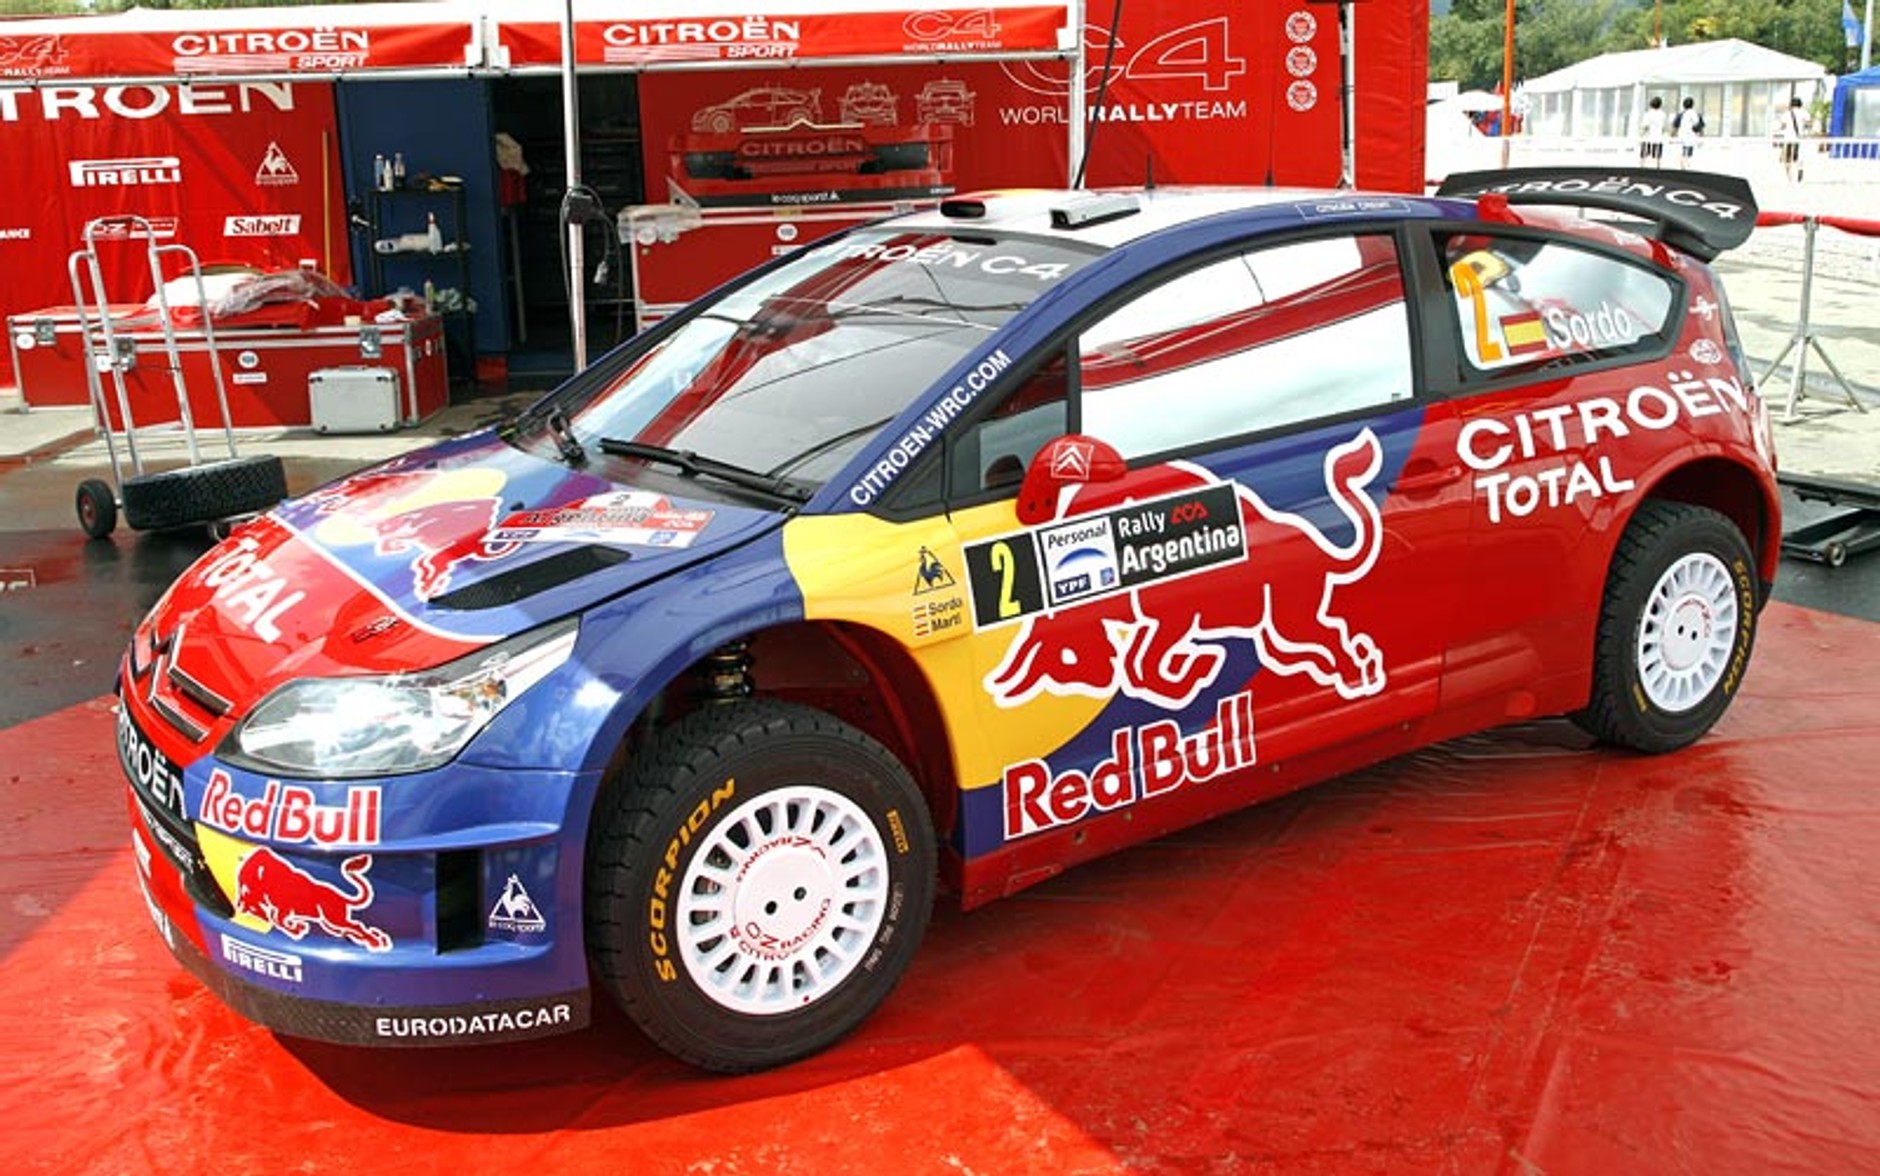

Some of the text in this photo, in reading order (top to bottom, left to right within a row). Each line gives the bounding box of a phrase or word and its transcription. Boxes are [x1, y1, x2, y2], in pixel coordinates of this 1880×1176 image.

[603, 15, 799, 45] CITROËN
[902, 7, 1002, 40] C4
[172, 26, 368, 56] CITROËN
[727, 45, 797, 58] SPORT
[296, 55, 366, 68] SPORT
[999, 100, 1247, 125] WORLRALLYTEAM
[740, 137, 864, 157] CITROËN
[69, 156, 181, 186] PIRELLI
[1666, 189, 1742, 219] C4
[980, 255, 1071, 281] C4
[1452, 262, 1503, 363] 2
[1548, 301, 1632, 347] Sordo
[850, 348, 1013, 506] CITROEN-WRC.COM
[1456, 370, 1748, 471] CITROËN
[1475, 456, 1635, 523] TOTAL
[1048, 521, 1108, 550] Personal
[1118, 511, 1165, 538] Rally
[1122, 524, 1240, 575] Argentina
[196, 536, 306, 644] TOTAL
[990, 541, 1021, 618] 2
[1057, 574, 1089, 595] YPF
[928, 597, 962, 615] Sordo
[1004, 690, 1256, 841] Red Bull
[200, 768, 281, 840] Red
[273, 784, 382, 846] Bull
[650, 777, 736, 982] SCORPION
[221, 933, 302, 982] PIRELLI
[375, 1003, 571, 1038] EURODATACAR
